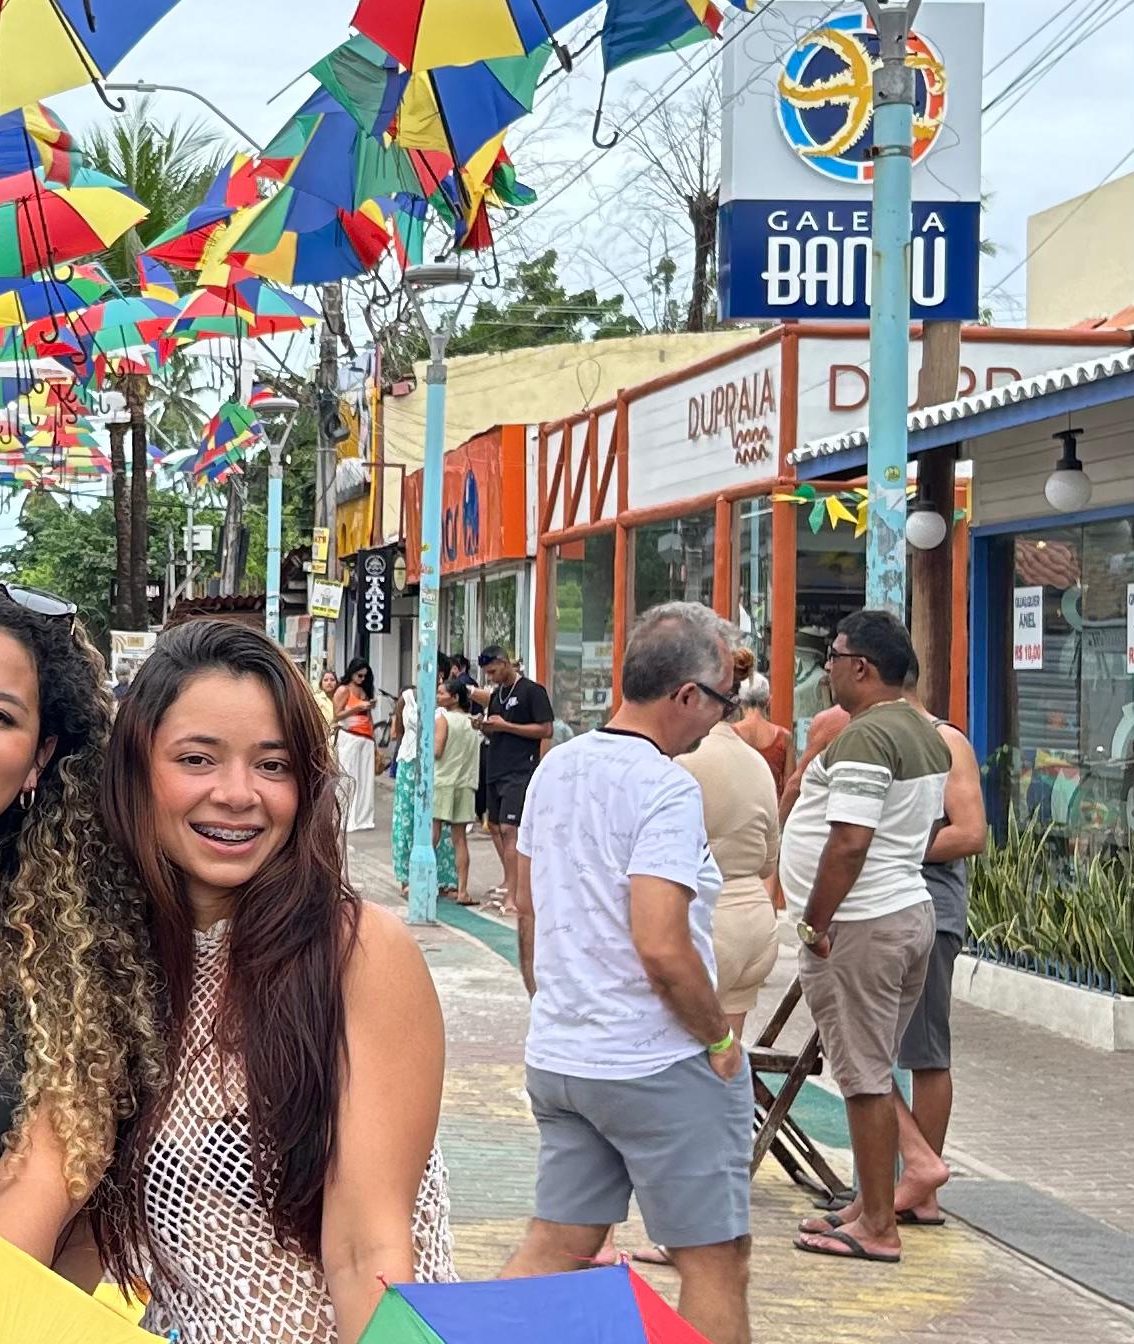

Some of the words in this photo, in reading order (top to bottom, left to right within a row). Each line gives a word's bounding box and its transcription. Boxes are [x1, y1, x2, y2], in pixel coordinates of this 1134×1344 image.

[767, 210, 945, 233] GALEA
[760, 236, 947, 307] BANU
[688, 368, 777, 444] DUPRAIA
[365, 575, 386, 632] TATTOO
